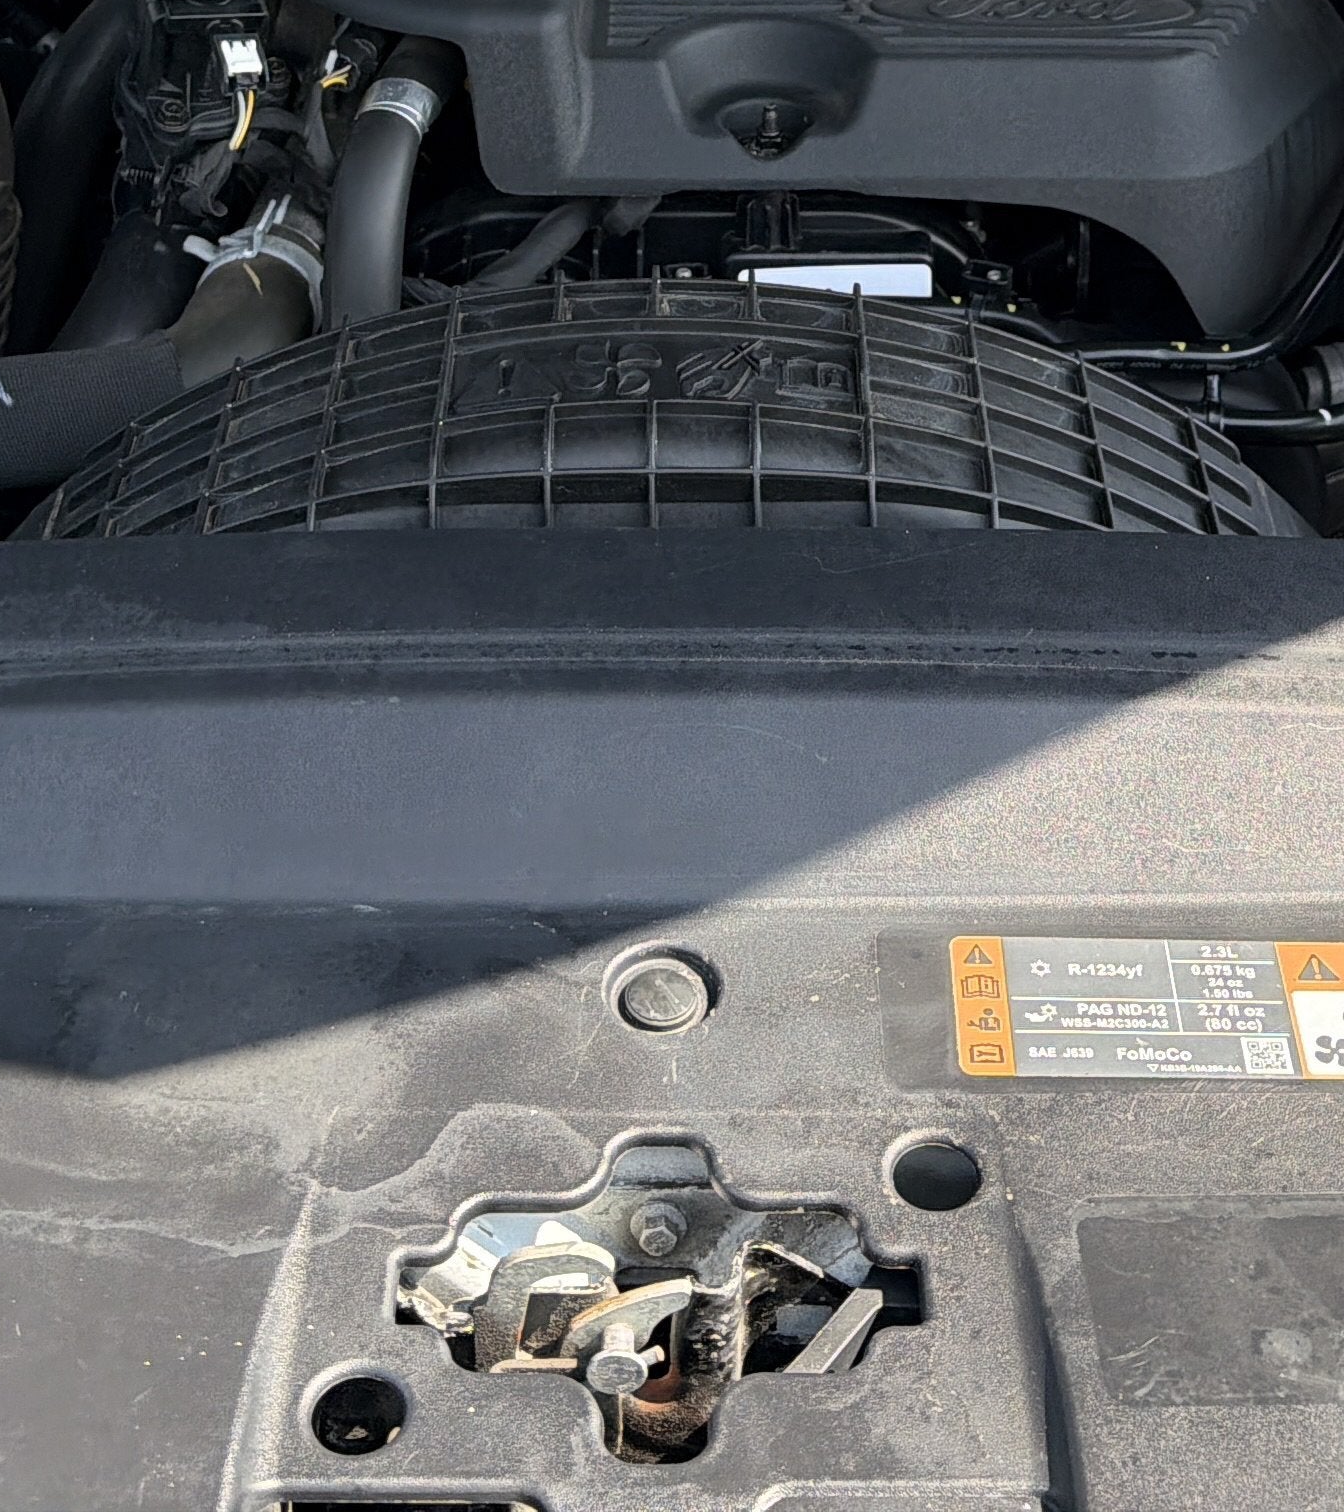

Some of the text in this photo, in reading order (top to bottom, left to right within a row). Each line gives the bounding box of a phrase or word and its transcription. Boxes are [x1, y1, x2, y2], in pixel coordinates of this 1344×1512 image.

[1200, 945, 1239, 959] 2.3L
[1068, 963, 1144, 979] R-1234yf
[1190, 964, 1256, 979] 0.675 kg
[1207, 977, 1244, 988] 24 oz
[1202, 987, 1254, 999] 1.50 lbs
[1076, 1002, 1168, 1017] PAG ND-12
[1197, 1004, 1266, 1017] 2.7 fl oz
[1205, 1018, 1263, 1033] (80 cc)
[1028, 1046, 1057, 1058] SAE
[1116, 1047, 1193, 1062] FoMoCo
